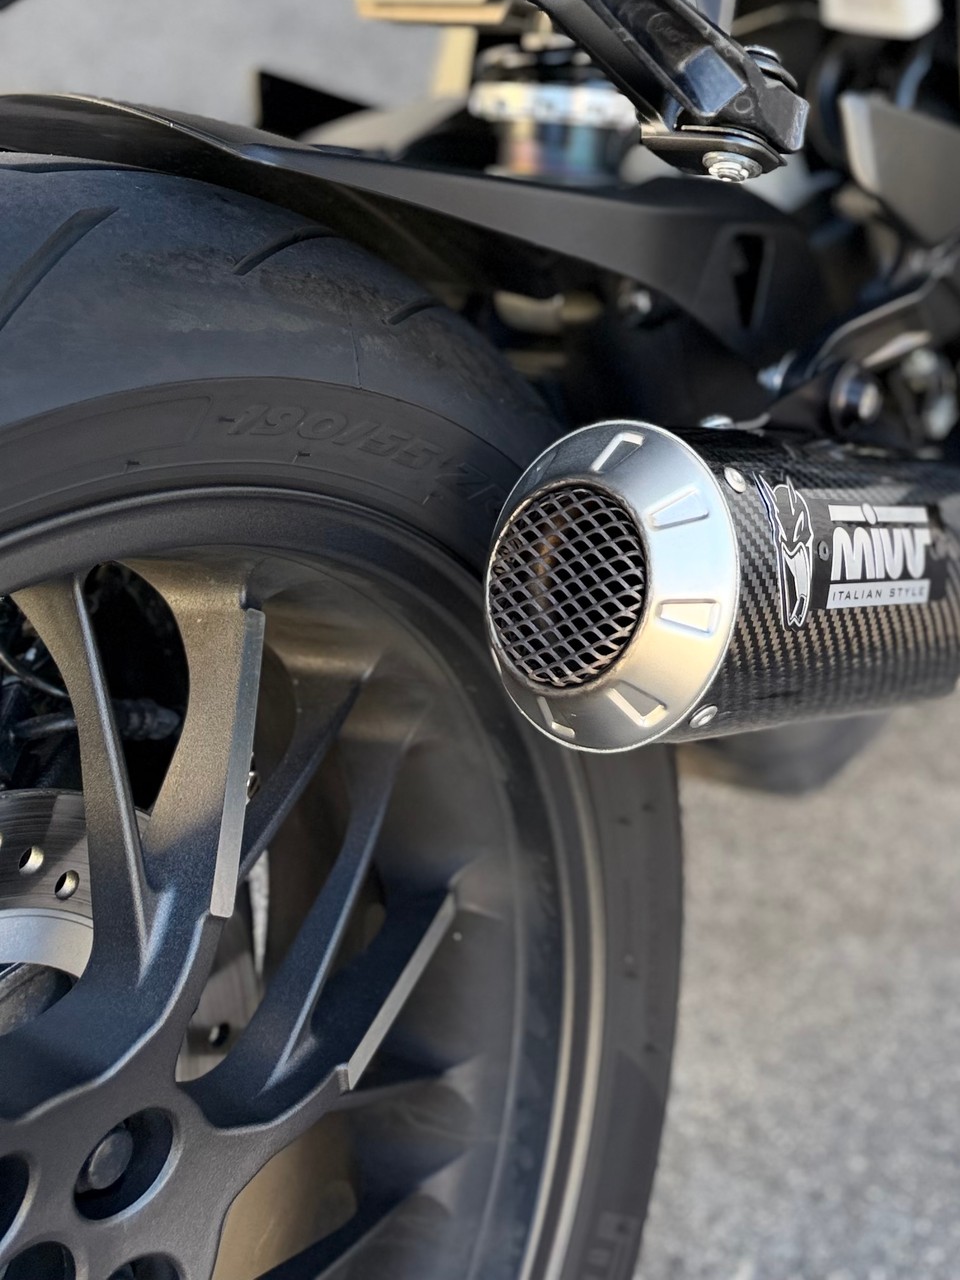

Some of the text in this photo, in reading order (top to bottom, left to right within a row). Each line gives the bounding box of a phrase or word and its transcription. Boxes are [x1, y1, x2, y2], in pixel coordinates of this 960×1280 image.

[227, 402, 445, 471] 190/55
[832, 586, 926, 602] ITALIAN STYLE
